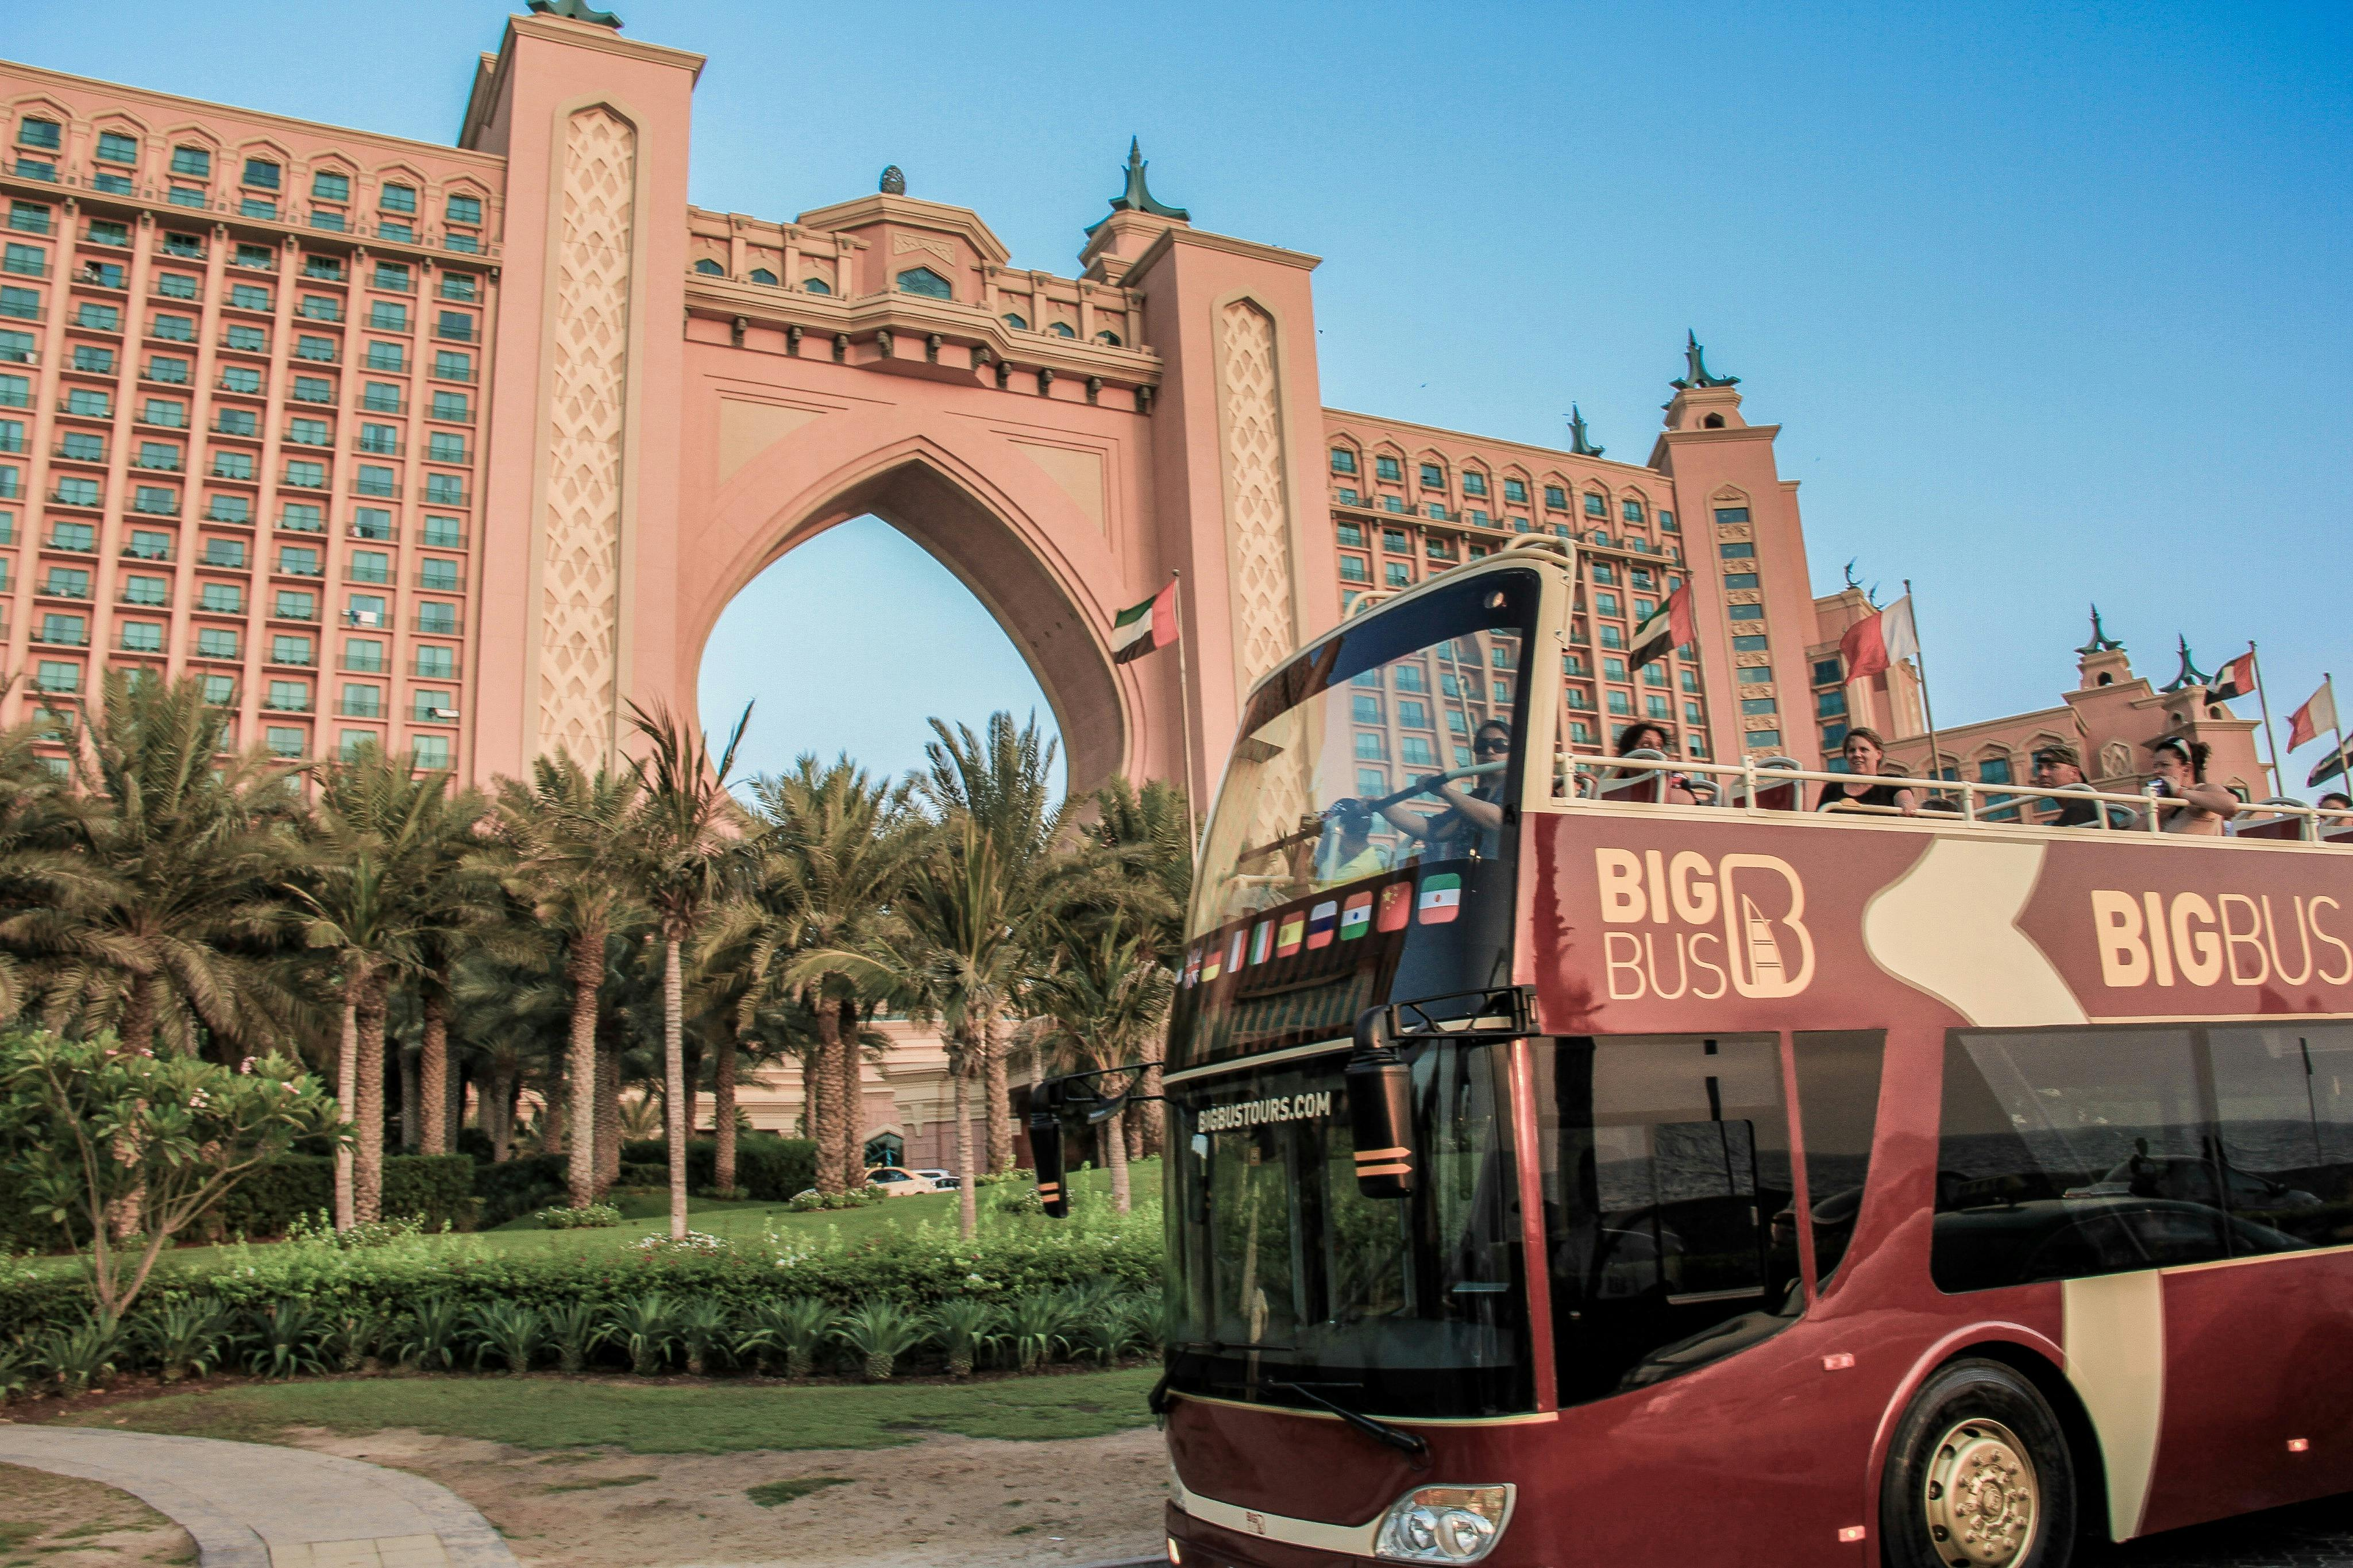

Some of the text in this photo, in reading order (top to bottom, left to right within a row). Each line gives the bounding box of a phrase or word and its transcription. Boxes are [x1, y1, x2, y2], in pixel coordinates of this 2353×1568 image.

[1595, 847, 1717, 925] BIG
[1603, 932, 1727, 999] BUS
[1198, 1091, 1331, 1133] BIGBUSTOURS.COM
